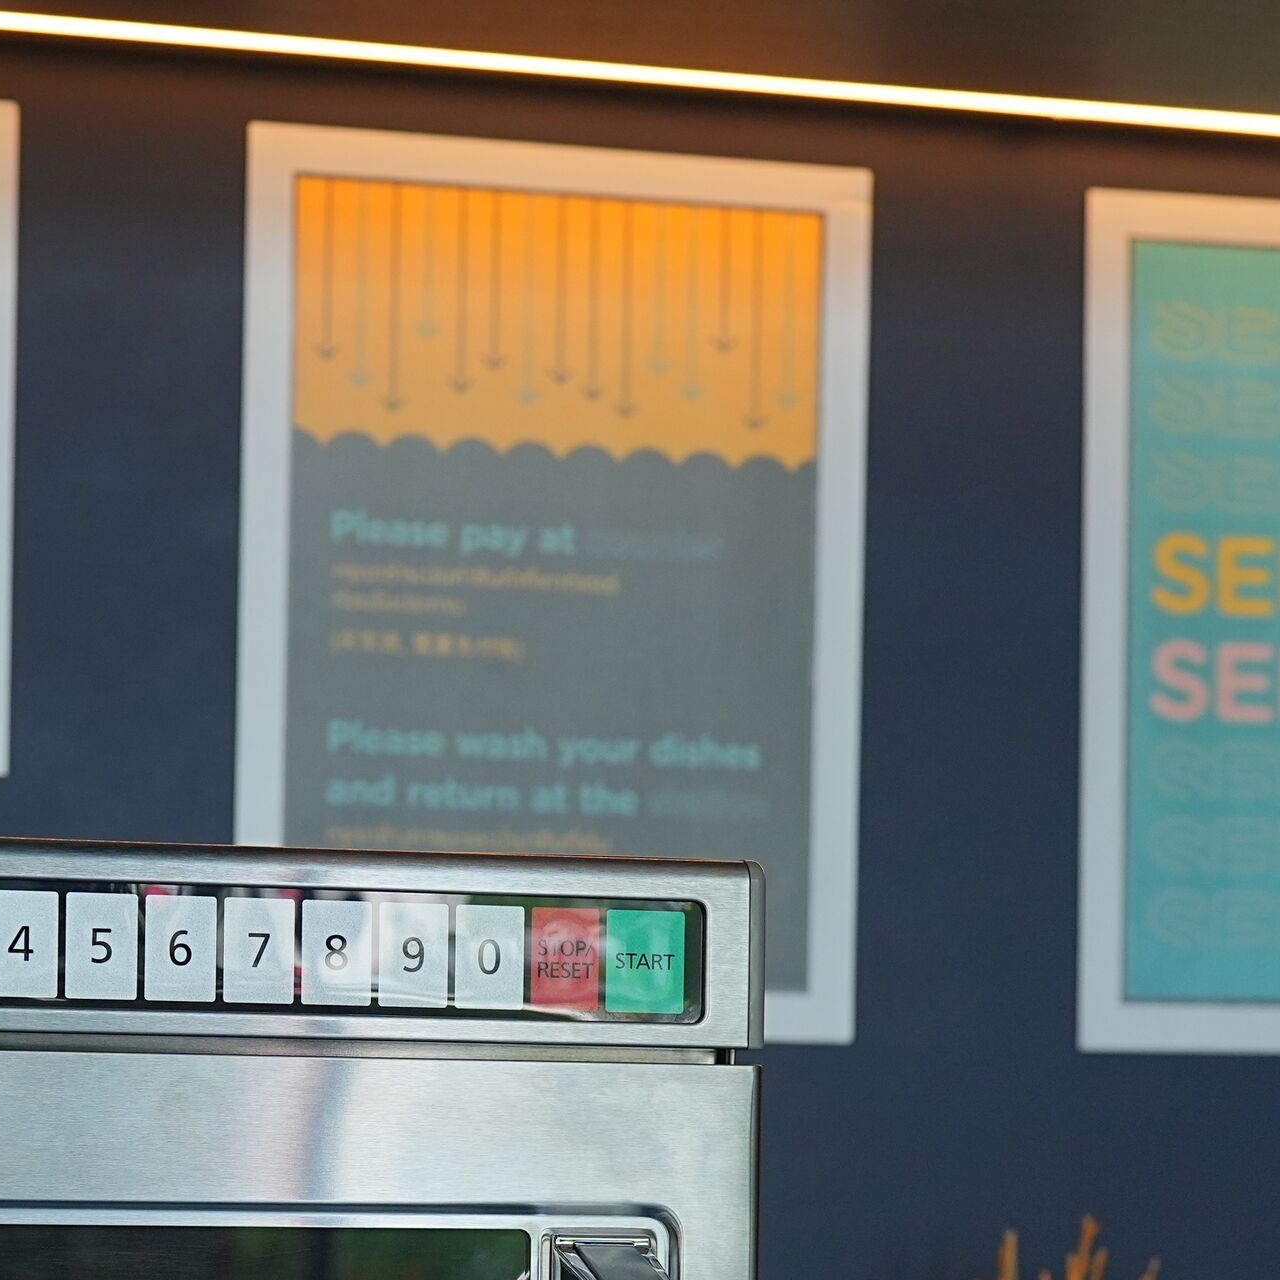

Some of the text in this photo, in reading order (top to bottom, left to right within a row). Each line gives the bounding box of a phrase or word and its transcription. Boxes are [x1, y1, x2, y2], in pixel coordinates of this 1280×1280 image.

[331, 508, 448, 554] Please
[459, 519, 528, 557] pay
[538, 522, 577, 556] at
[327, 718, 762, 772] Please wash your dishes
[326, 773, 396, 808] and
[407, 777, 520, 812] return
[530, 780, 568, 814] at
[579, 781, 639, 817] the
[7, 925, 34, 962] 4
[91, 927, 113, 964] 5
[169, 929, 192, 967] 6
[248, 932, 271, 968] 7
[324, 934, 349, 972] 8
[402, 936, 425, 973] 9
[477, 938, 501, 975] 0
[537, 938, 594, 958] STOP/
[615, 951, 676, 970] START
[537, 961, 594, 980] RESET
